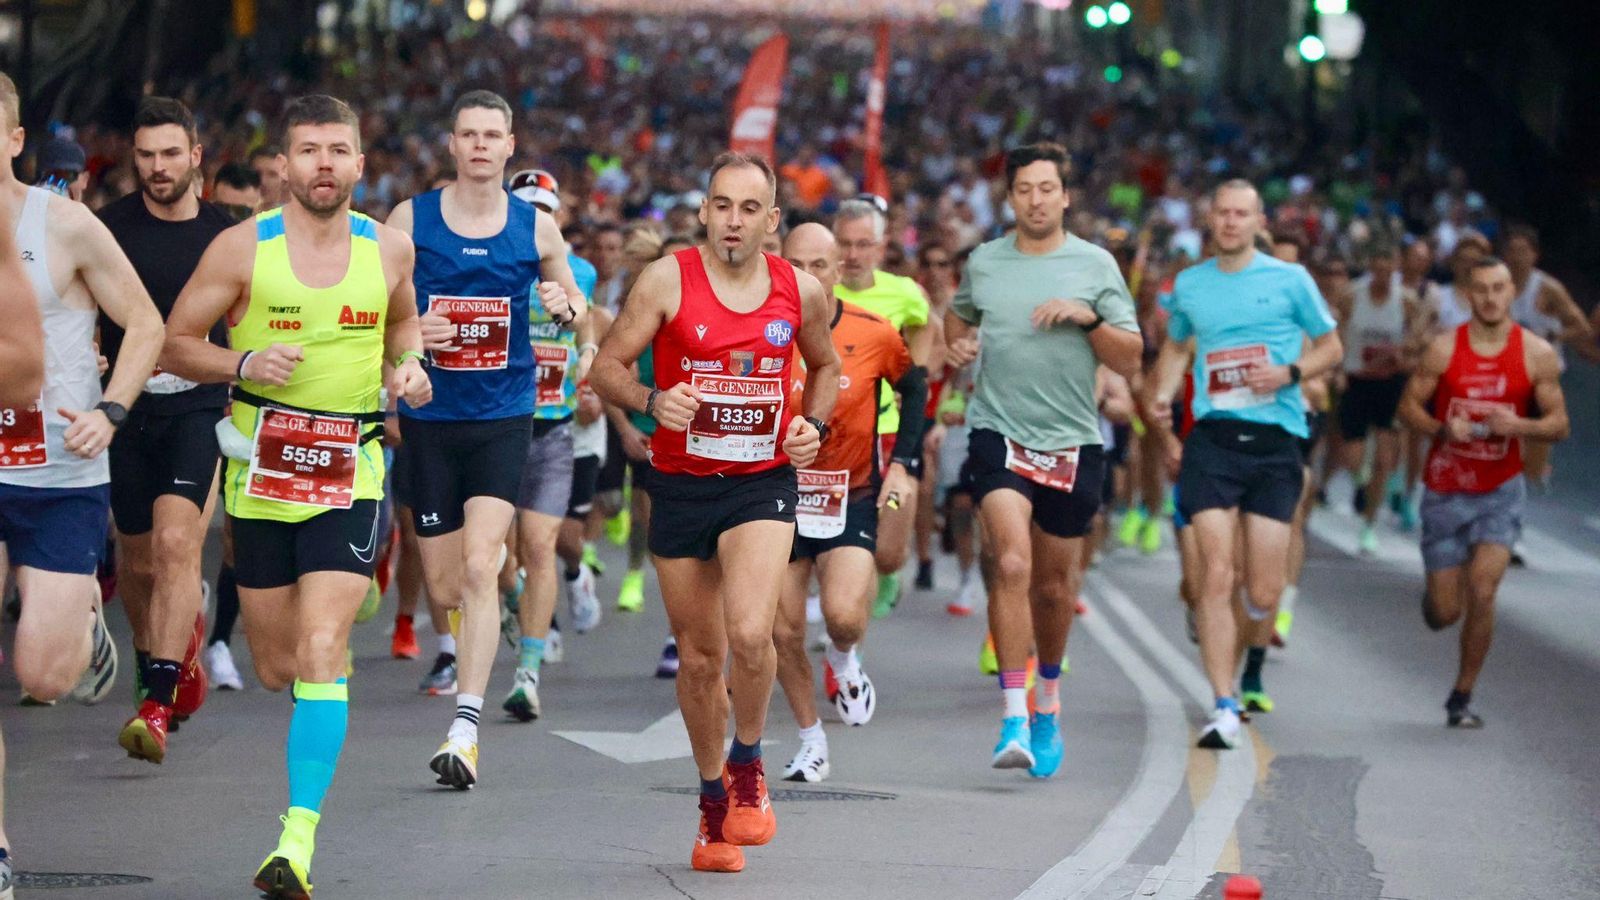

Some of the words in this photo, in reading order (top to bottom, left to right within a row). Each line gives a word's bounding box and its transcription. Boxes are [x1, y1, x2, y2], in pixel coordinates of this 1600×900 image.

[463, 247, 488, 256] FUSION
[268, 306, 301, 314] TRIMTEX
[451, 301, 504, 313] GENERALI
[338, 305, 379, 325] Anu
[719, 381, 775, 395] GENERALI
[711, 407, 764, 424] 13339
[288, 417, 353, 437] GENERALI
[719, 424, 753, 432] SALVATORE
[281, 444, 332, 467] 5558
[796, 473, 842, 485] ENERALI
